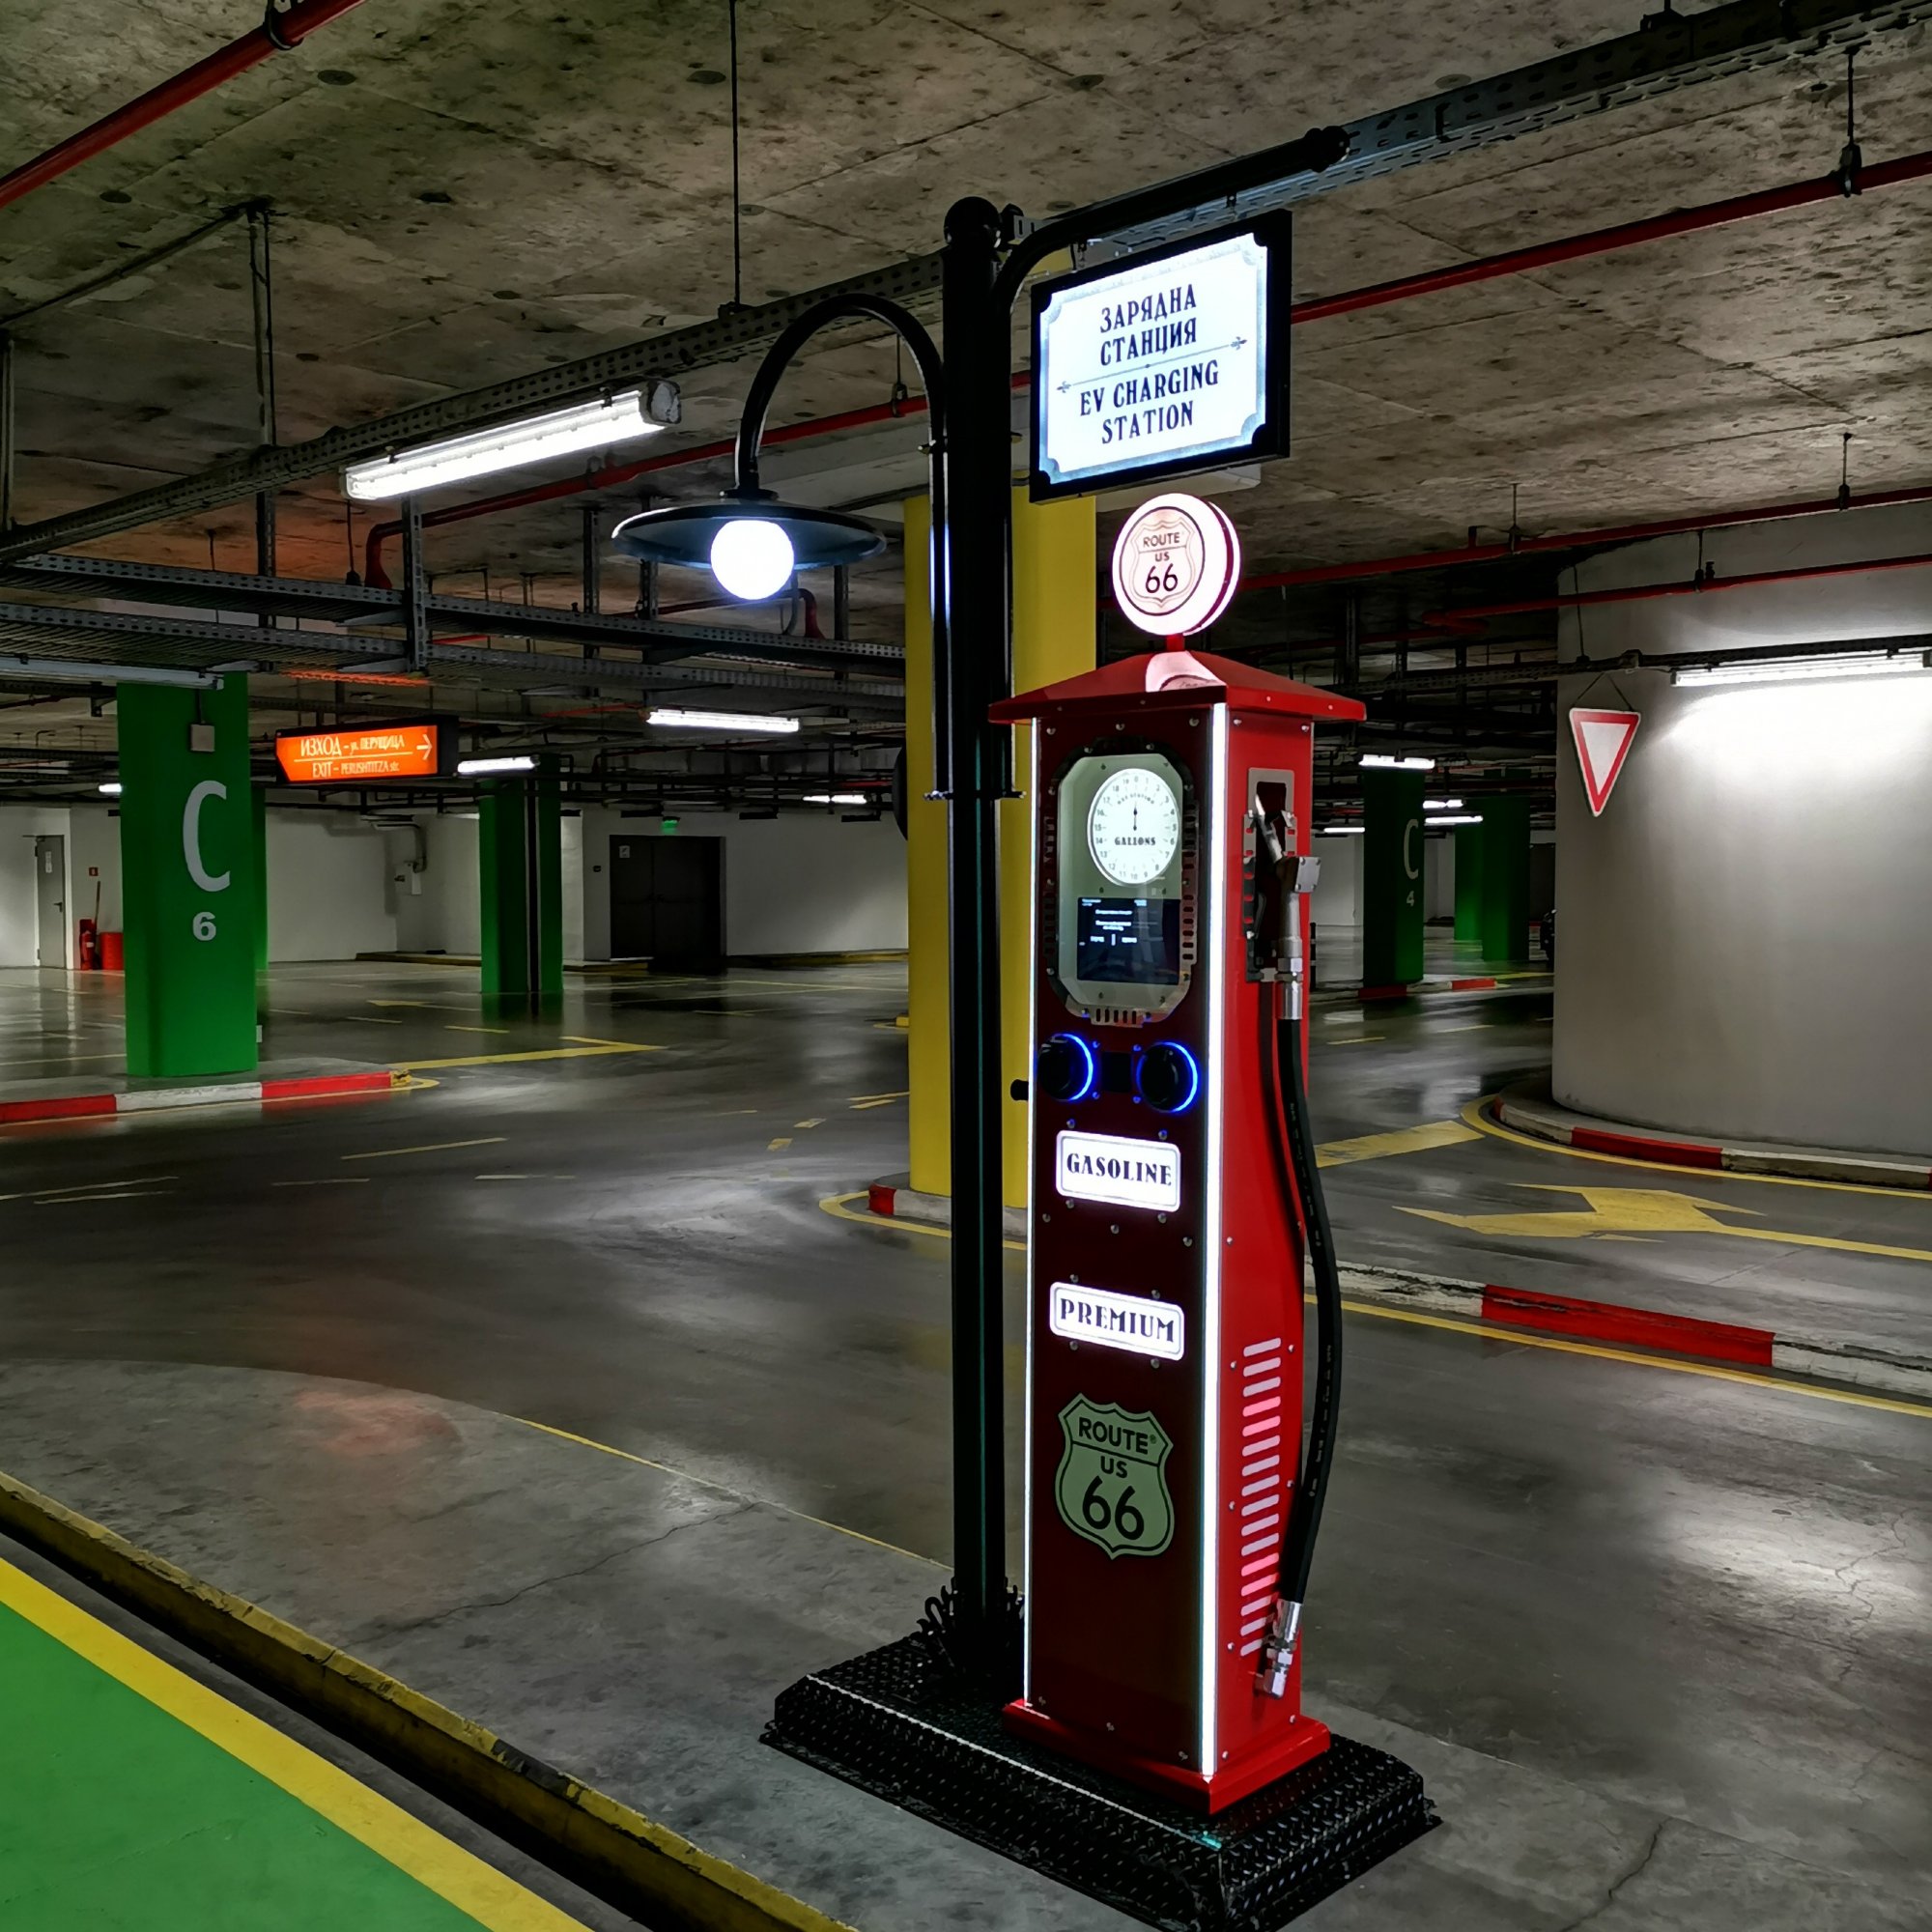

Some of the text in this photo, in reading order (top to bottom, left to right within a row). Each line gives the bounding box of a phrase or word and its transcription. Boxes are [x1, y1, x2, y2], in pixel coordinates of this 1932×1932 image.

[1100, 284, 1197, 333] ЗАРЯДНА
[1100, 317, 1197, 366] СТАНЦИЯ
[1080, 359, 1219, 416] EV CHARGING
[1101, 400, 1194, 444] STATION
[1143, 532, 1180, 548] ROUTE
[1154, 552, 1170, 562] US
[1146, 563, 1179, 593] 66
[300, 736, 342, 757] ИЗХОД
[312, 761, 332, 779] EXIT
[183, 781, 231, 892] C
[1114, 837, 1156, 846] GALLONS
[1404, 818, 1419, 880] C
[1406, 890, 1414, 907] 4
[192, 911, 216, 941] 6
[1066, 1152, 1172, 1186] GASOLINE
[1060, 1297, 1175, 1343] PREMIUM
[1078, 1416, 1149, 1455] ROUTE
[1100, 1456, 1128, 1479] US
[1082, 1475, 1145, 1541] 66
